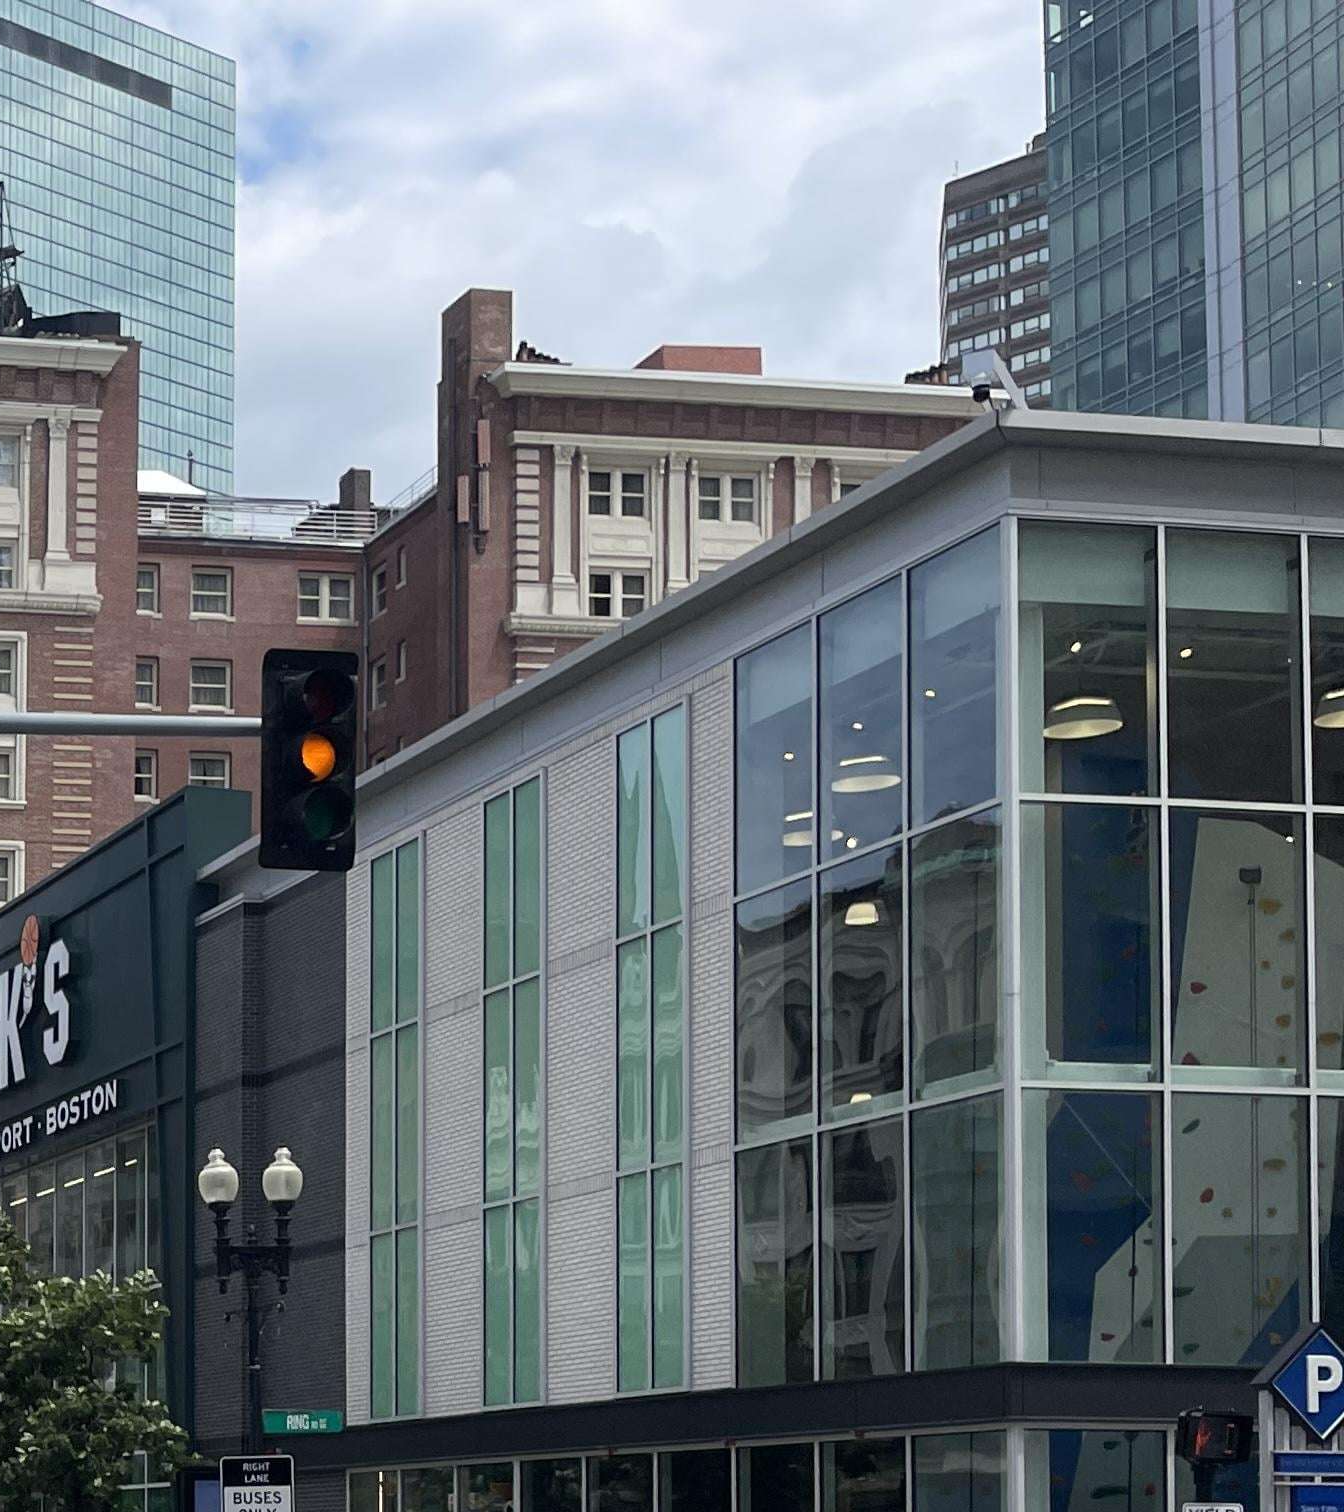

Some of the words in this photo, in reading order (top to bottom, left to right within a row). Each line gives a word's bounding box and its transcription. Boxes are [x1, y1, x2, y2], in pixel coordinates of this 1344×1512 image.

[45, 1078, 119, 1137] BOSTON
[287, 1414, 310, 1430] RING
[243, 1461, 270, 1472] RIGHT
[244, 1473, 270, 1483] LANE
[233, 1491, 282, 1505] BUSES
